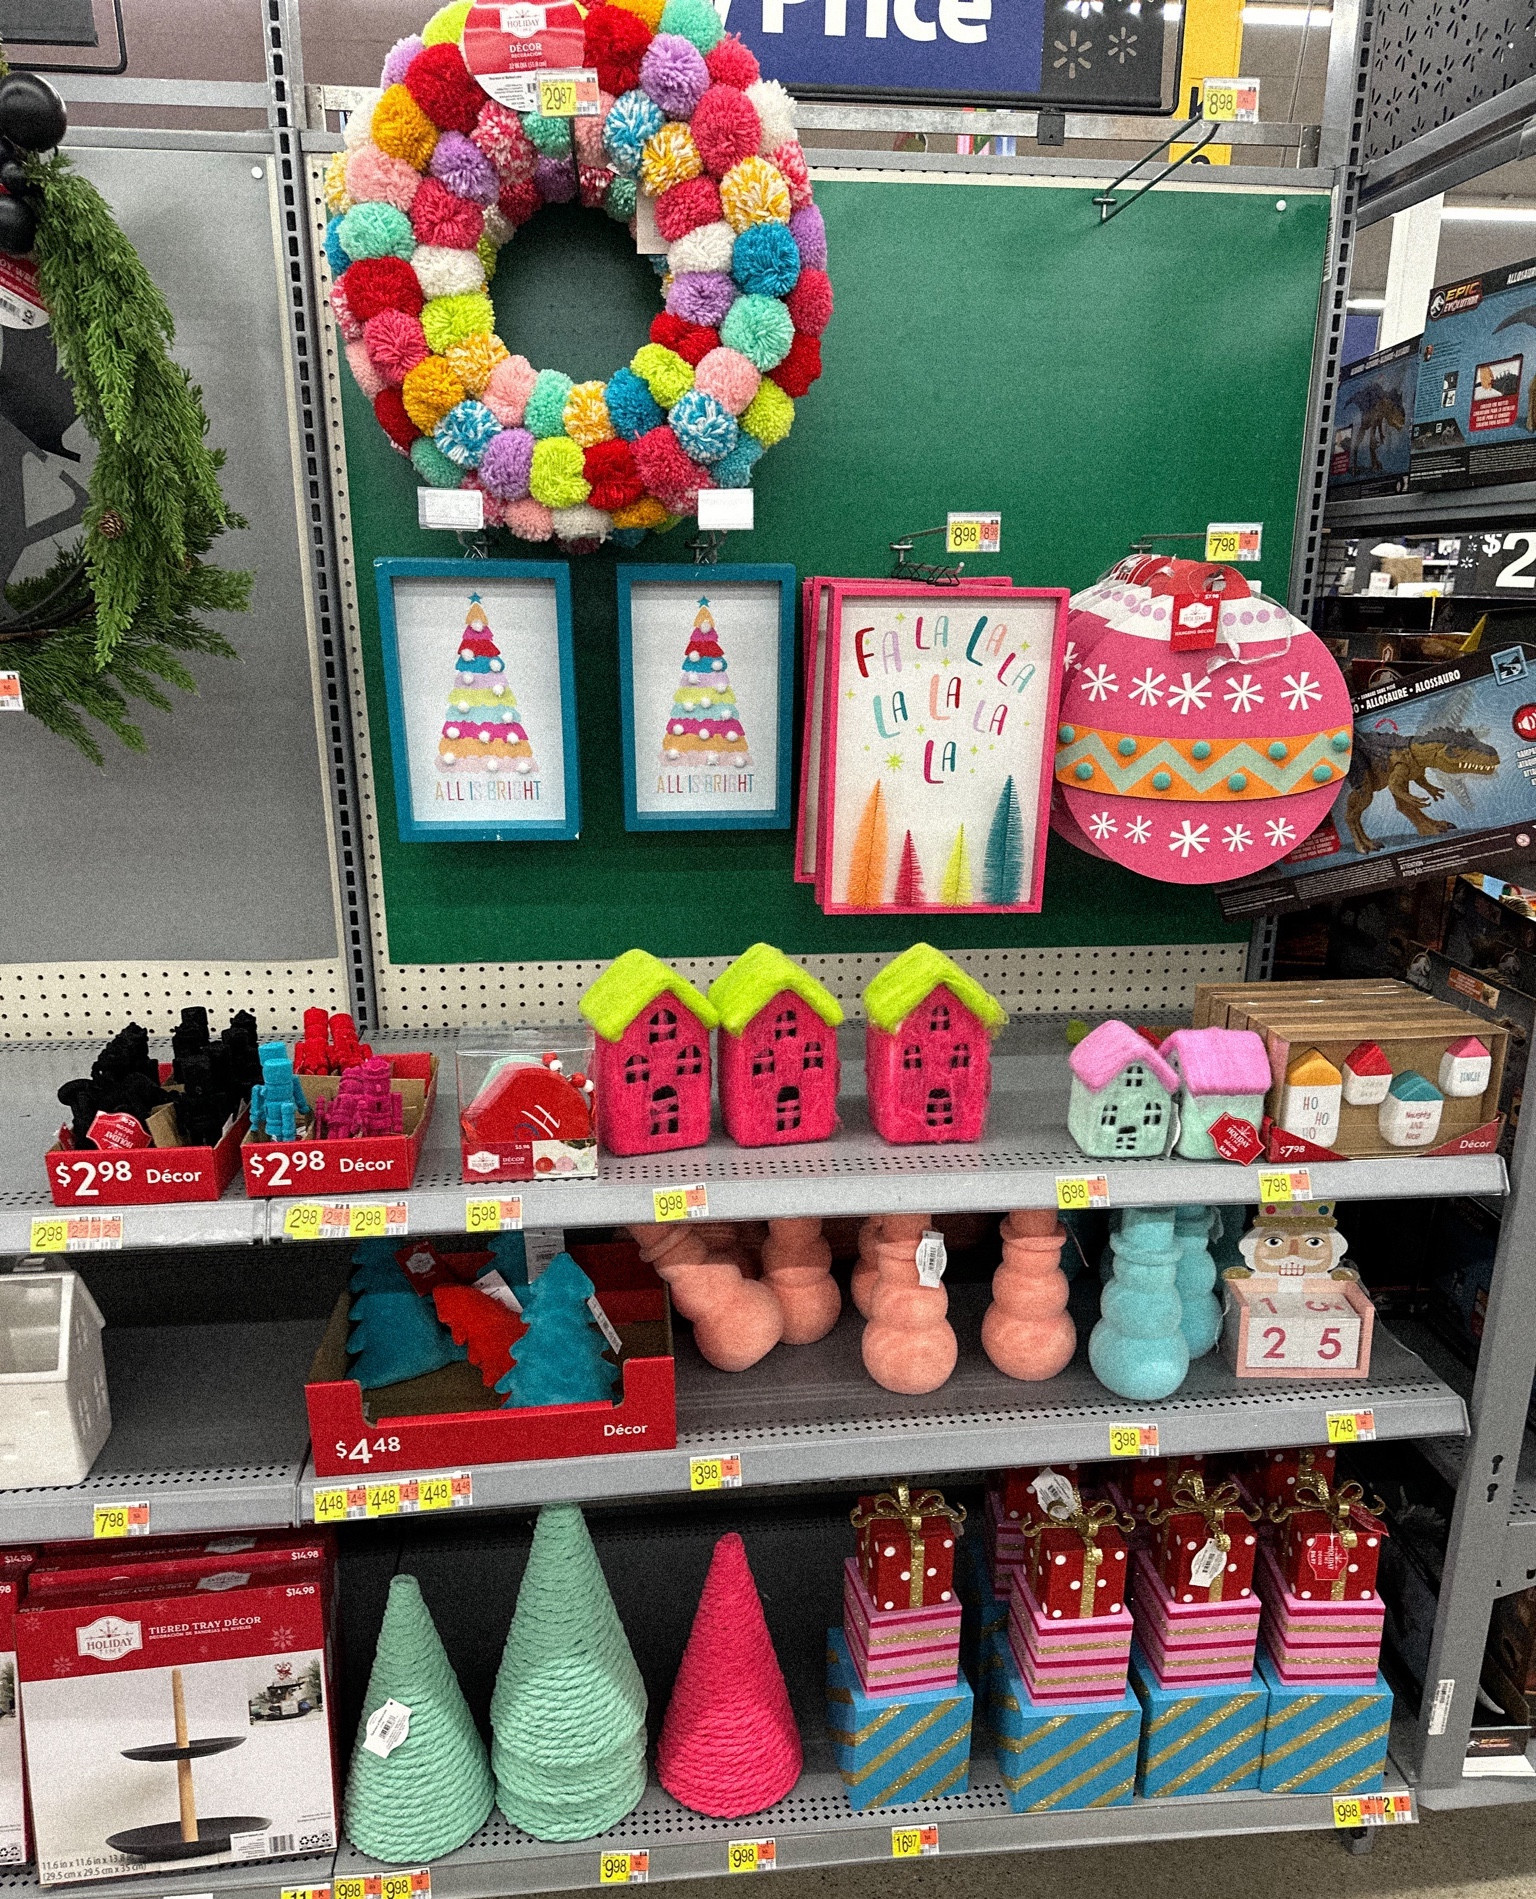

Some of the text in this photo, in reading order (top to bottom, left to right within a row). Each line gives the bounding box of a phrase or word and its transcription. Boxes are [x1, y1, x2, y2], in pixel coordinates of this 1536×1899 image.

[507, 19, 540, 28] HOLIDAY
[509, 42, 542, 53] DÉCOR
[1445, 281, 1480, 301] EPIC
[916, 615, 949, 650] LA
[855, 615, 1008, 678] FA LA
[997, 653, 1036, 694] LA
[1366, 686, 1409, 710] ALLOSAURE
[1414, 669, 1461, 693] ALOSSAURO
[873, 674, 1008, 739] LA LA LA
[923, 740, 957, 784] LA
[435, 780, 541, 801] ALL IS BRIGHT
[657, 774, 755, 794] ALL IS BRIGHT
[1303, 1096, 1318, 1111] HO
[1315, 1112, 1329, 1126] HO
[104, 1131, 133, 1149] HOLIDAY
[1227, 1127, 1251, 1148] HOLIDAY
[1459, 1139, 1491, 1149] Décor
[339, 1158, 394, 1173] Décor
[146, 1168, 202, 1184] Décor
[604, 1424, 648, 1437] Décor
[4, 1555, 33, 1564] $14.98
[291, 1550, 319, 1561] $14.98
[1327, 1545, 1335, 1570] HOLIDAY
[285, 1586, 315, 1597] $14.98
[149, 1616, 262, 1635] TIERED TRAY DÉCOR
[149, 1632, 184, 1640] DECORACIÓN
[230, 1624, 252, 1632] NIVELES
[87, 1637, 133, 1651] HOLIDAY
[42, 1861, 58, 1870] 11.6
[60, 1861, 67, 1869] in
[76, 1858, 92, 1866] 11.6
[109, 1853, 124, 1862] 13.8
[43, 1872, 62, 1881] (29.5
[83, 1867, 100, 1876] 29.5
[121, 1864, 131, 1872] 35
[132, 1863, 146, 1871] cm)
